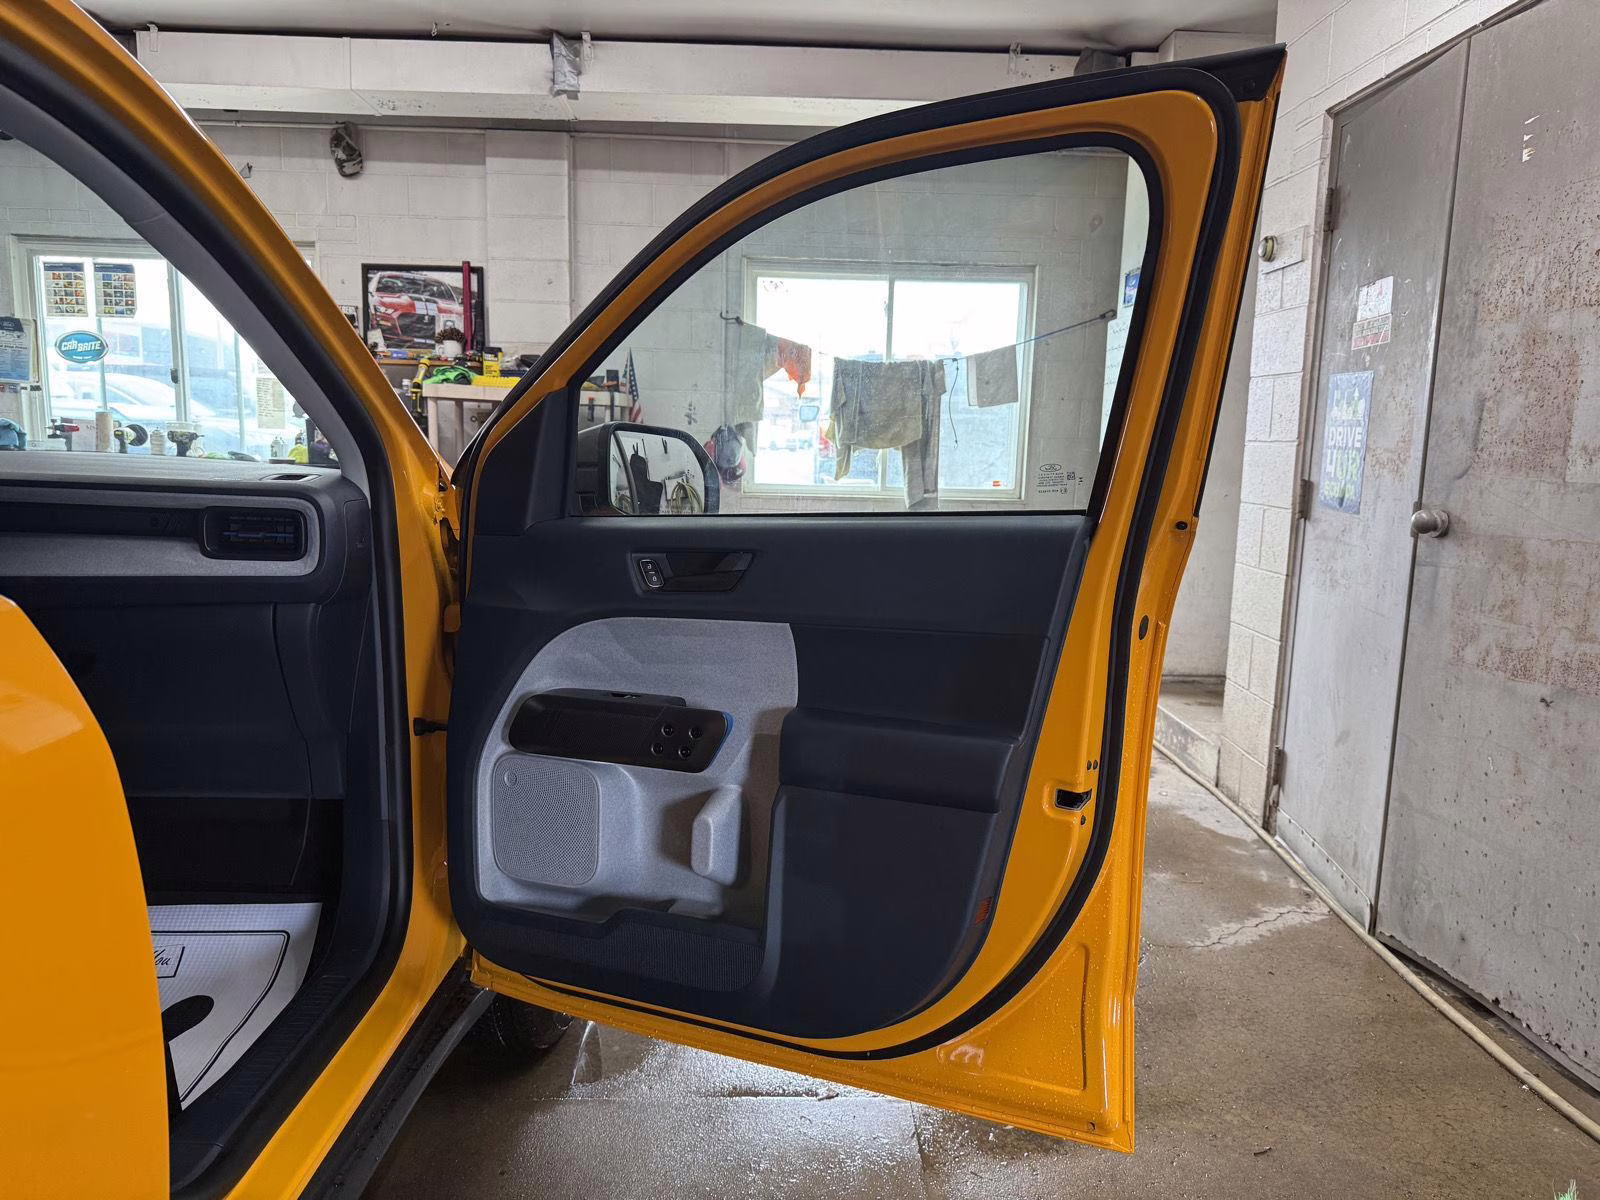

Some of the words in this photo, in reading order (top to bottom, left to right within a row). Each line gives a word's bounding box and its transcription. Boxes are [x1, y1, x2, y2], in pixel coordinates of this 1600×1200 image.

[61, 338, 78, 351] CAR
[77, 340, 102, 352] BRITE
[1328, 426, 1363, 448] DRIVE
